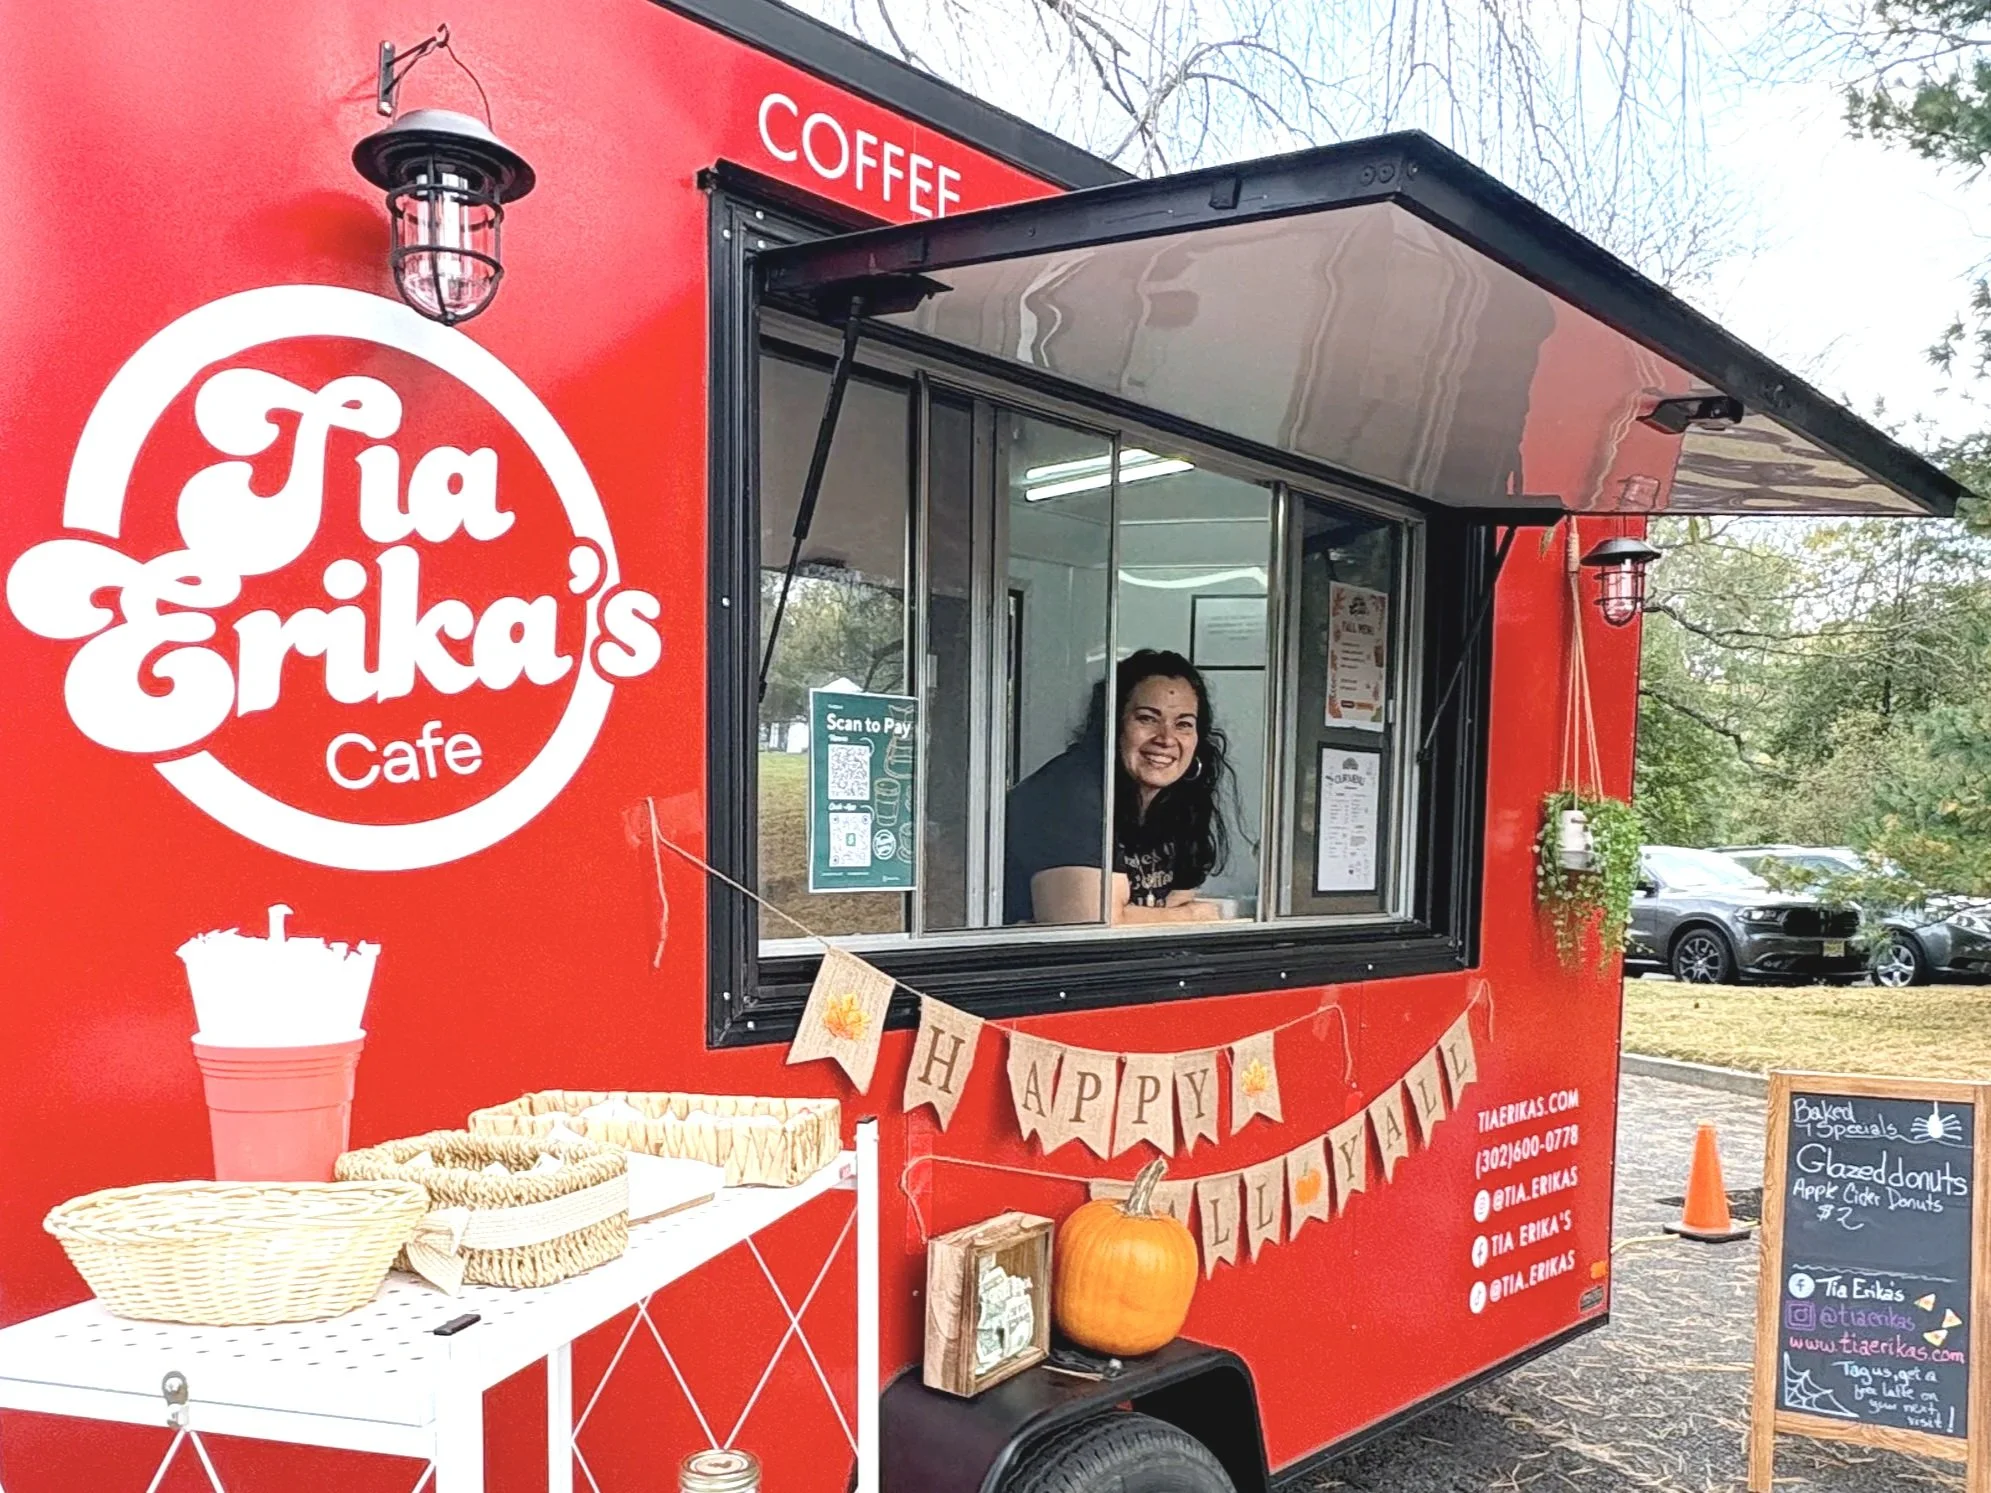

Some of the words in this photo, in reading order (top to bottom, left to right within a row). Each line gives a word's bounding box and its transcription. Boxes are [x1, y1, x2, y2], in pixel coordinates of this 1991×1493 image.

[758, 93, 962, 218] COFFEE
[177, 368, 515, 576] Tia
[6, 539, 663, 754] Erika's
[826, 712, 863, 732] Scan
[865, 717, 881, 733] to
[883, 717, 911, 739] Pay
[326, 719, 483, 790] Cafe
[917, 1025, 1210, 1125] HAPPY
[1339, 1042, 1468, 1182] Y'ALL
[1477, 1088, 1580, 1133] TIAERIKAS.COM
[1792, 1097, 1856, 1123] Baked
[1816, 1113, 1898, 1140] Specials
[1475, 1124, 1580, 1180] (302)600-0778
[1796, 1143, 1887, 1185] Glazed
[1888, 1156, 1968, 1196] donuts
[1492, 1166, 1579, 1213] @TIA.ERIKAS
[1792, 1177, 1839, 1202] Apple
[1843, 1181, 1881, 1207] Cider
[1885, 1186, 1944, 1213] Donuts
[1491, 1231, 1514, 1257] TIA
[1519, 1209, 1573, 1247] ERIKA'S
[1489, 1249, 1576, 1302] @TIA.ERIKAS
[1815, 1275, 1848, 1299] Tia
[1819, 1302, 1916, 1332] @tiaerikas
[1789, 1331, 1966, 1365] www.tiaerikas.com
[1831, 1360, 1873, 1386] Tag
[1924, 1370, 1938, 1383] a
[1854, 1384, 1878, 1401] free
[1920, 1391, 1940, 1403] on
[1868, 1399, 1898, 1414] your
